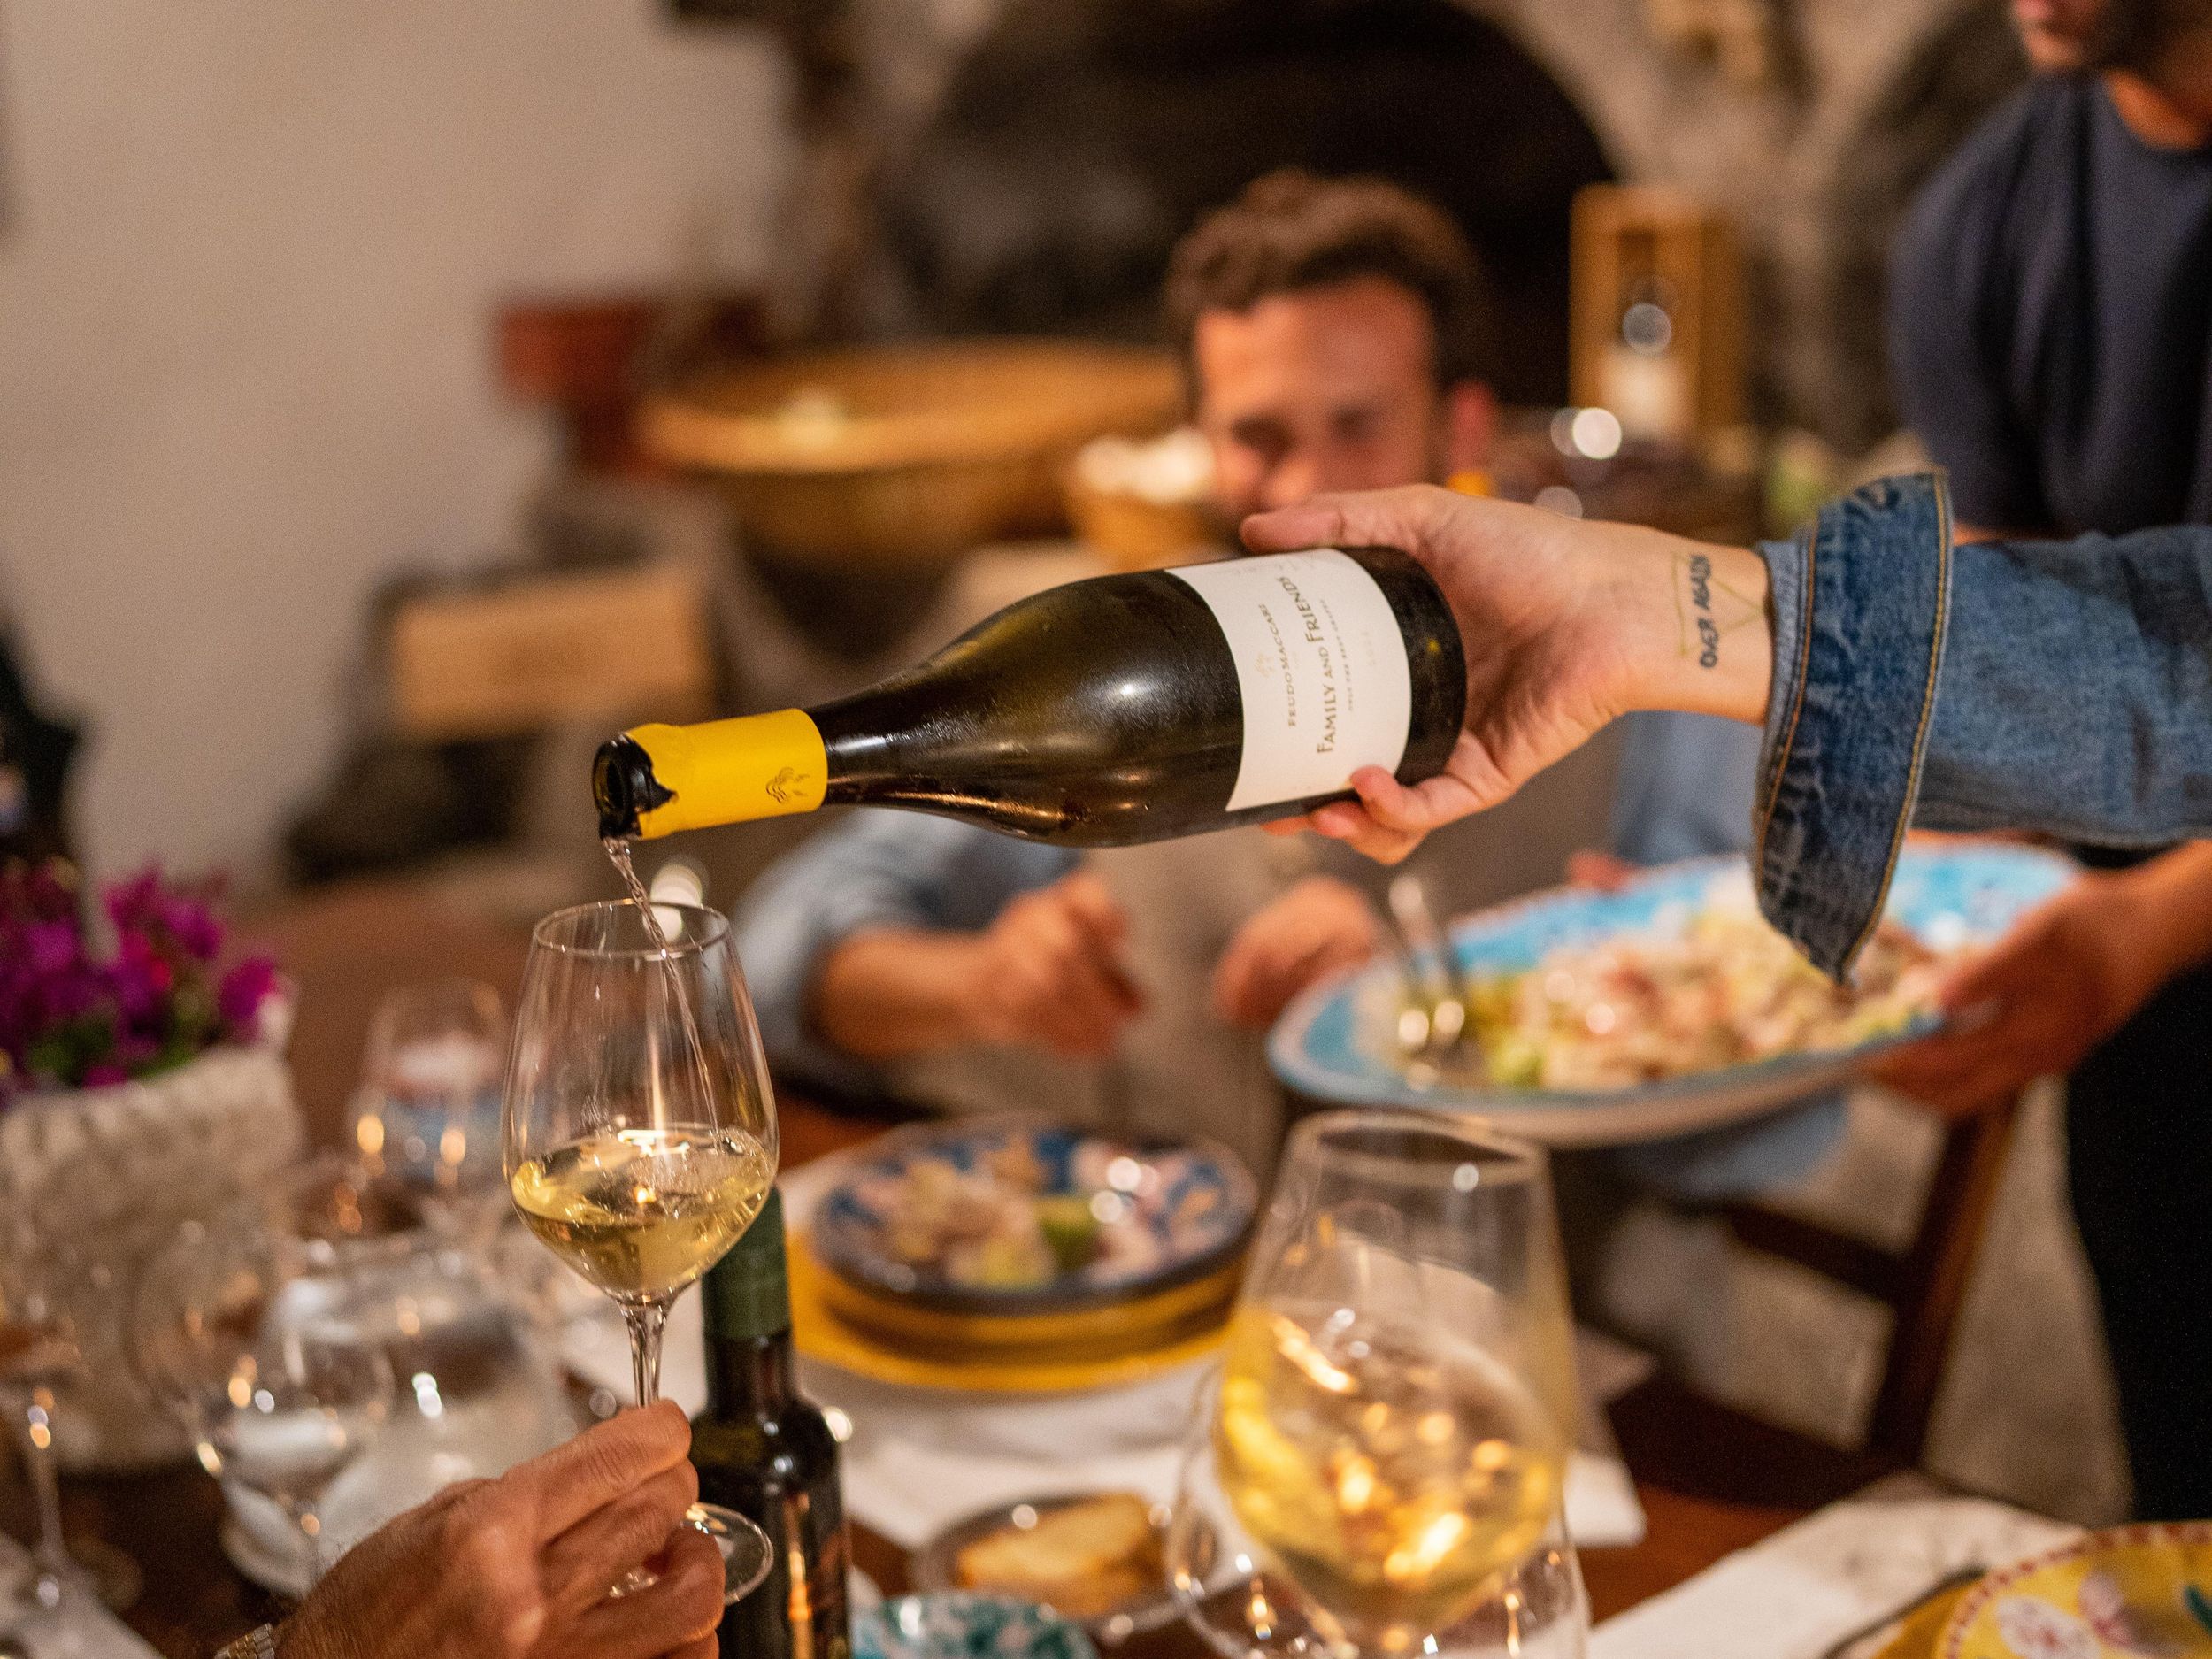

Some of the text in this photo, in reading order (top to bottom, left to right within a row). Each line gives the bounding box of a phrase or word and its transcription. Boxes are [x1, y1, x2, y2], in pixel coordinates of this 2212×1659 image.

[1258, 603, 1296, 727] FEUDO MACCARI
[1276, 576, 1337, 754] FAMILY AND FRIENDS
